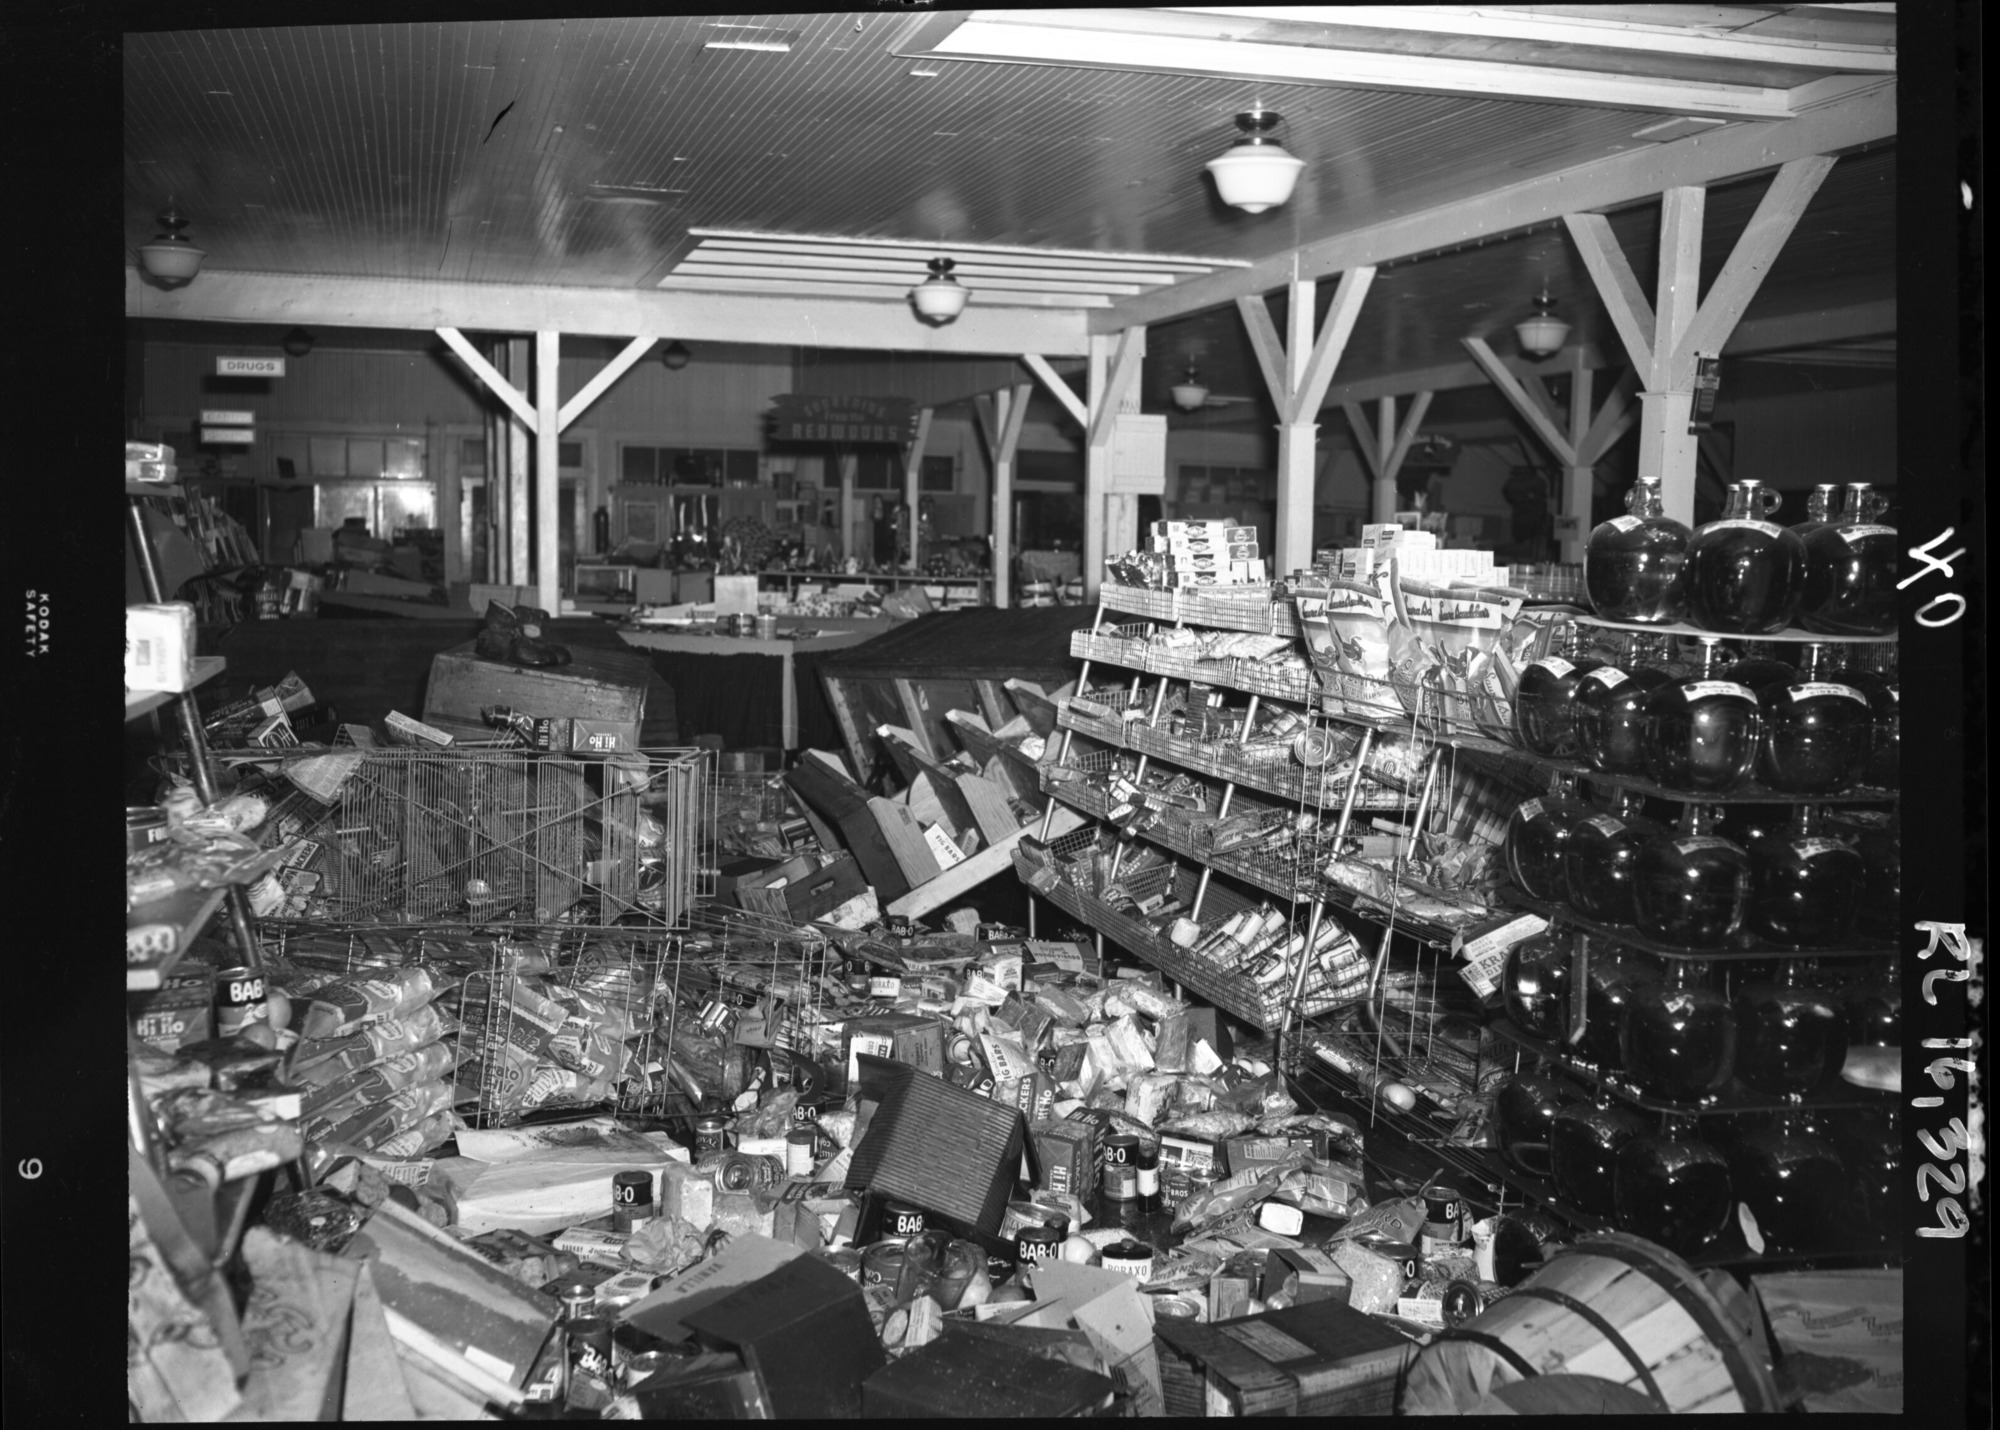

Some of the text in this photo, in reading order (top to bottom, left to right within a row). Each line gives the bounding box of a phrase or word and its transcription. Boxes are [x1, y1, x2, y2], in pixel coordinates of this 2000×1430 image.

[227, 361, 275, 372] DRUGS
[792, 423, 898, 441] REDWOODS
[25, 589, 37, 658] SAFETY
[39, 593, 50, 654] KODAK
[538, 719, 550, 746] Hi Ho
[589, 736, 616, 748] Hi Ho
[935, 834, 960, 862] FIG BARS
[230, 979, 263, 1002] BAB
[992, 1044, 1008, 1067] BARS
[1018, 1077, 1032, 1113] CKERS
[1170, 1188, 1188, 1198] BROS
[897, 1215, 923, 1233] BAB
